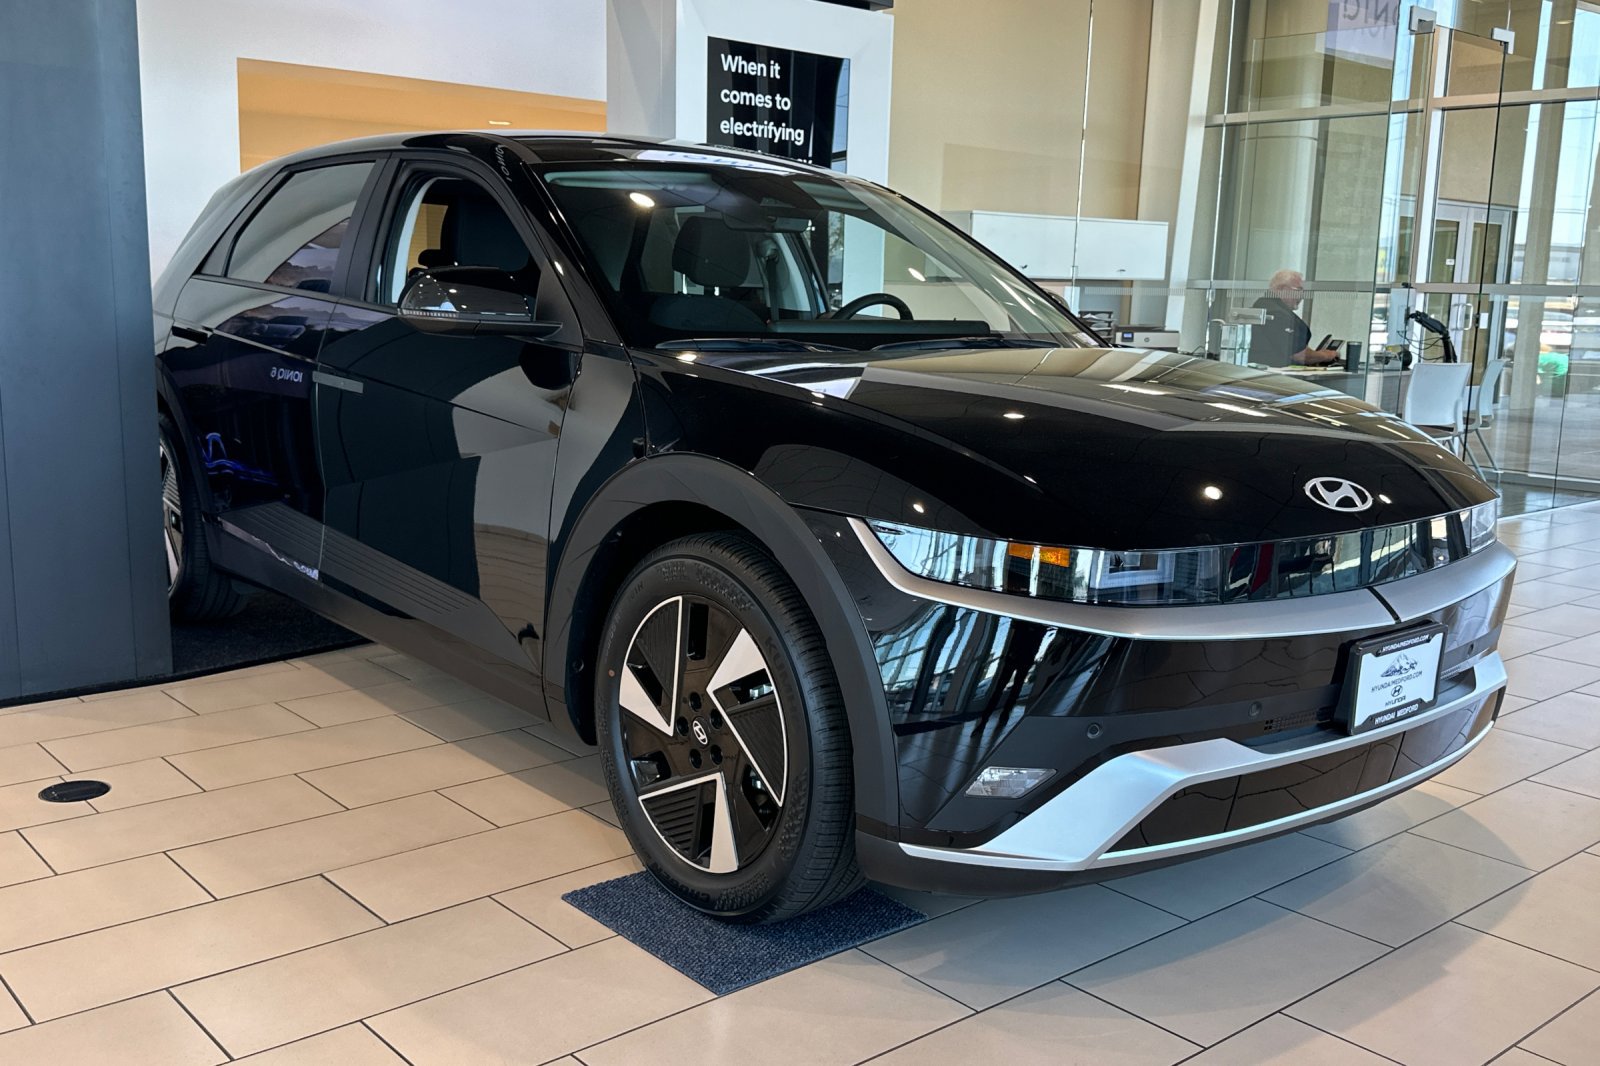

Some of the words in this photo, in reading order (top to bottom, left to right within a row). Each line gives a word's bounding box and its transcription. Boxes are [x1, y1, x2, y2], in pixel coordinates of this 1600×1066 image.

[720, 53, 767, 77] When
[770, 60, 781, 79] it
[720, 89, 773, 109] comes
[775, 93, 792, 111] to
[720, 117, 805, 146] electrifying
